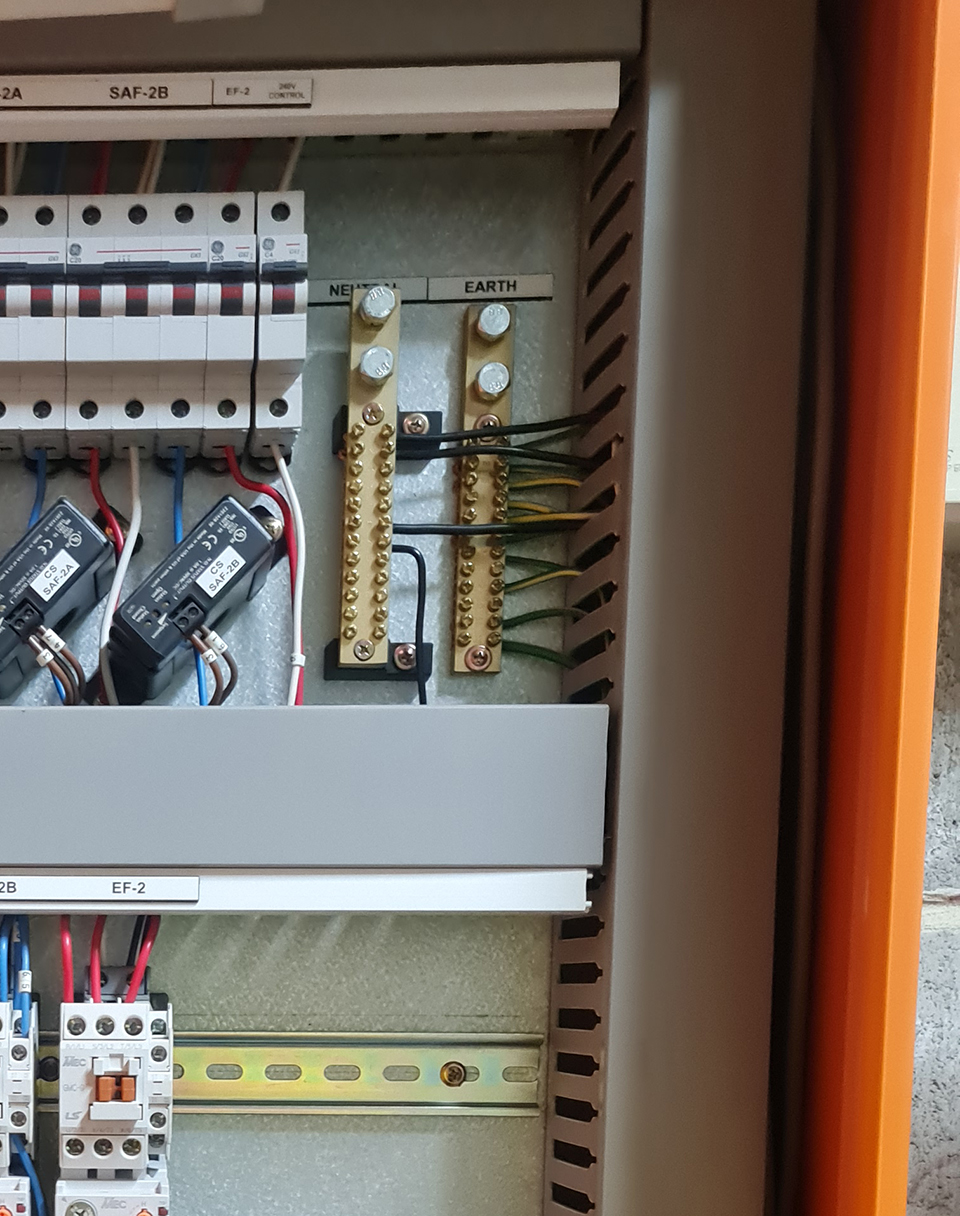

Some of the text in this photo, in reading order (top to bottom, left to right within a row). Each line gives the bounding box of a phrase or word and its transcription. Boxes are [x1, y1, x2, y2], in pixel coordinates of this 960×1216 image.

[109, 84, 169, 100] SAF-2B
[225, 86, 251, 97] EF-2
[268, 91, 305, 100] CONTROL
[465, 280, 517, 294] EARTH
[44, 564, 58, 579] CS
[210, 560, 224, 575] CS
[43, 563, 74, 596] SAF-2A
[208, 559, 239, 592] SAF-2B
[111, 880, 146, 894] EF-2
[21, 971, 29, 991] 65
